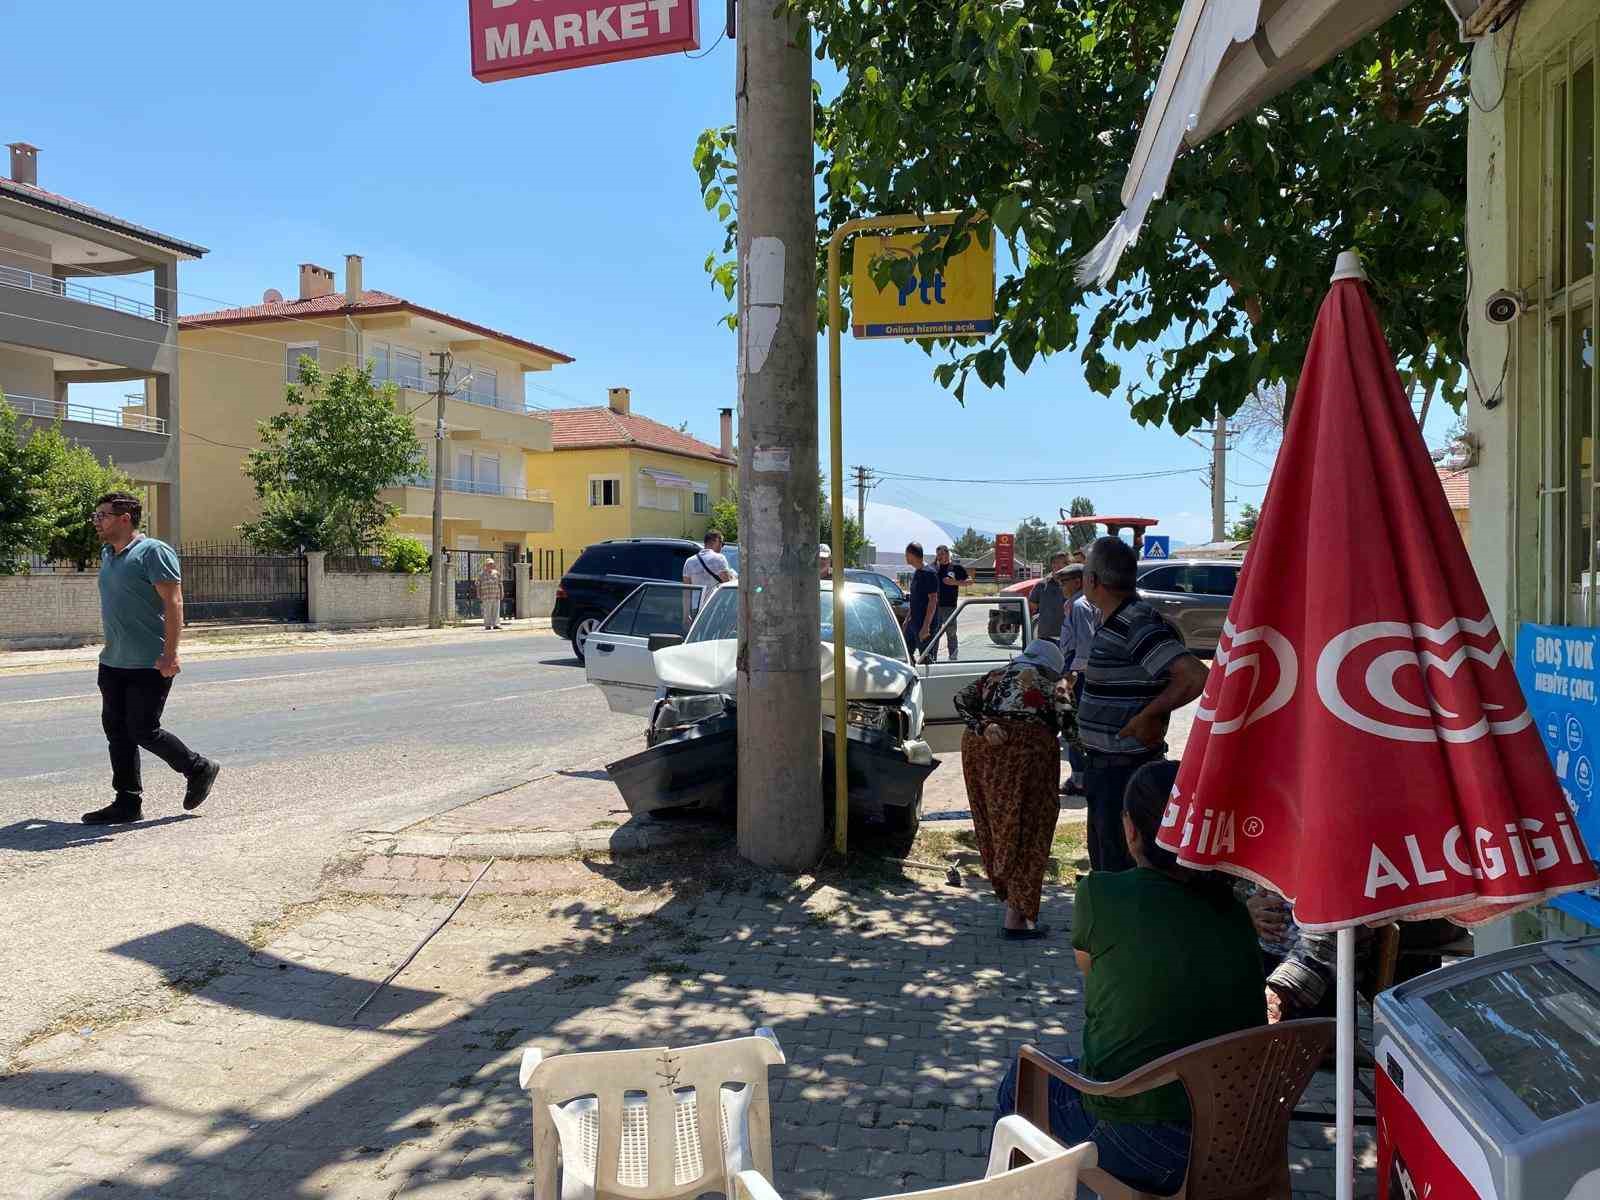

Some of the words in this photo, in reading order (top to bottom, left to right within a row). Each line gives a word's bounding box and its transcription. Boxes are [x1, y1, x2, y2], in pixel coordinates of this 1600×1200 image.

[485, 0, 679, 61] MARKET
[1535, 636, 1562, 671] BOŞ
[1564, 639, 1594, 671] YOK
